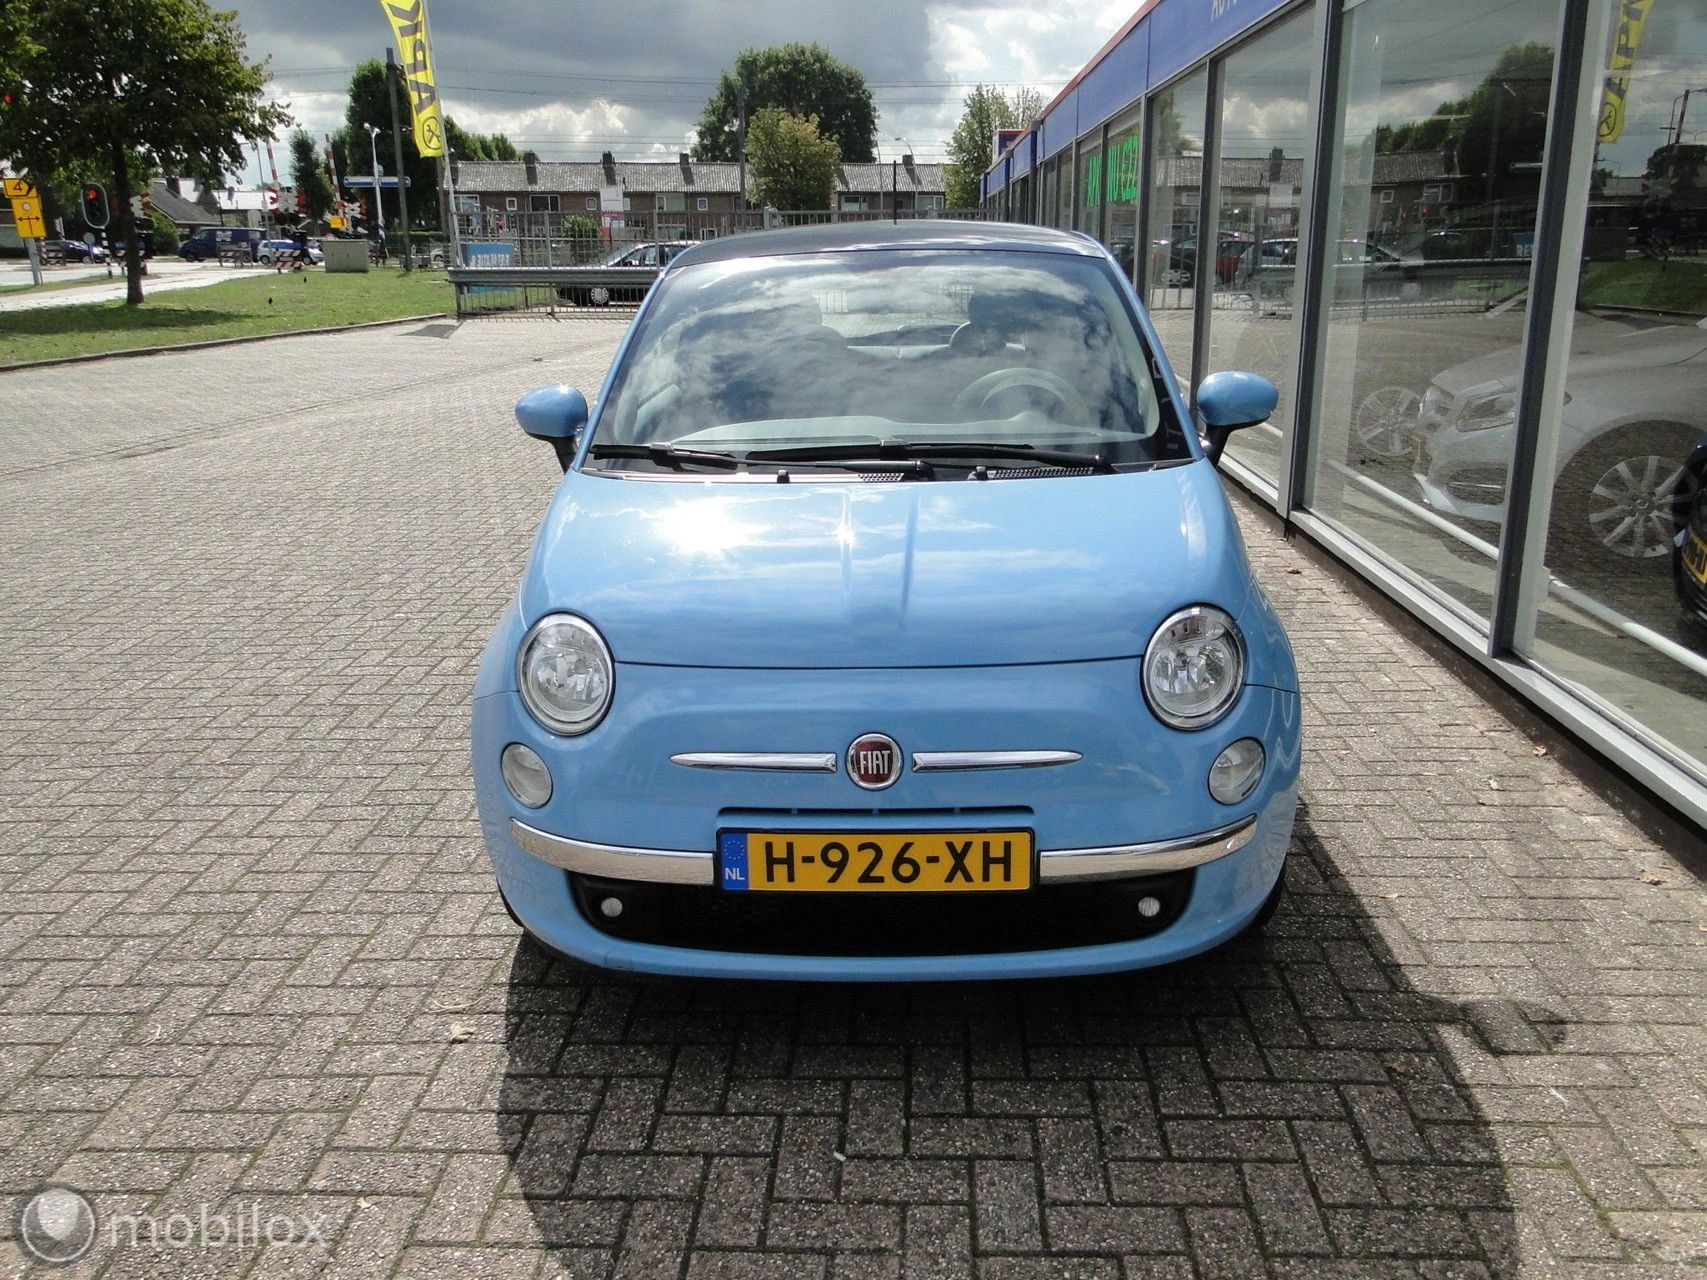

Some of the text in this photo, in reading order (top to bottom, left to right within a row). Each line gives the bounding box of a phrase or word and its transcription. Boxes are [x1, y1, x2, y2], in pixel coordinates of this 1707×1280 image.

[859, 750, 891, 775] FIAT
[724, 867, 745, 881] NL
[764, 841, 1012, 884] H-926-XH
